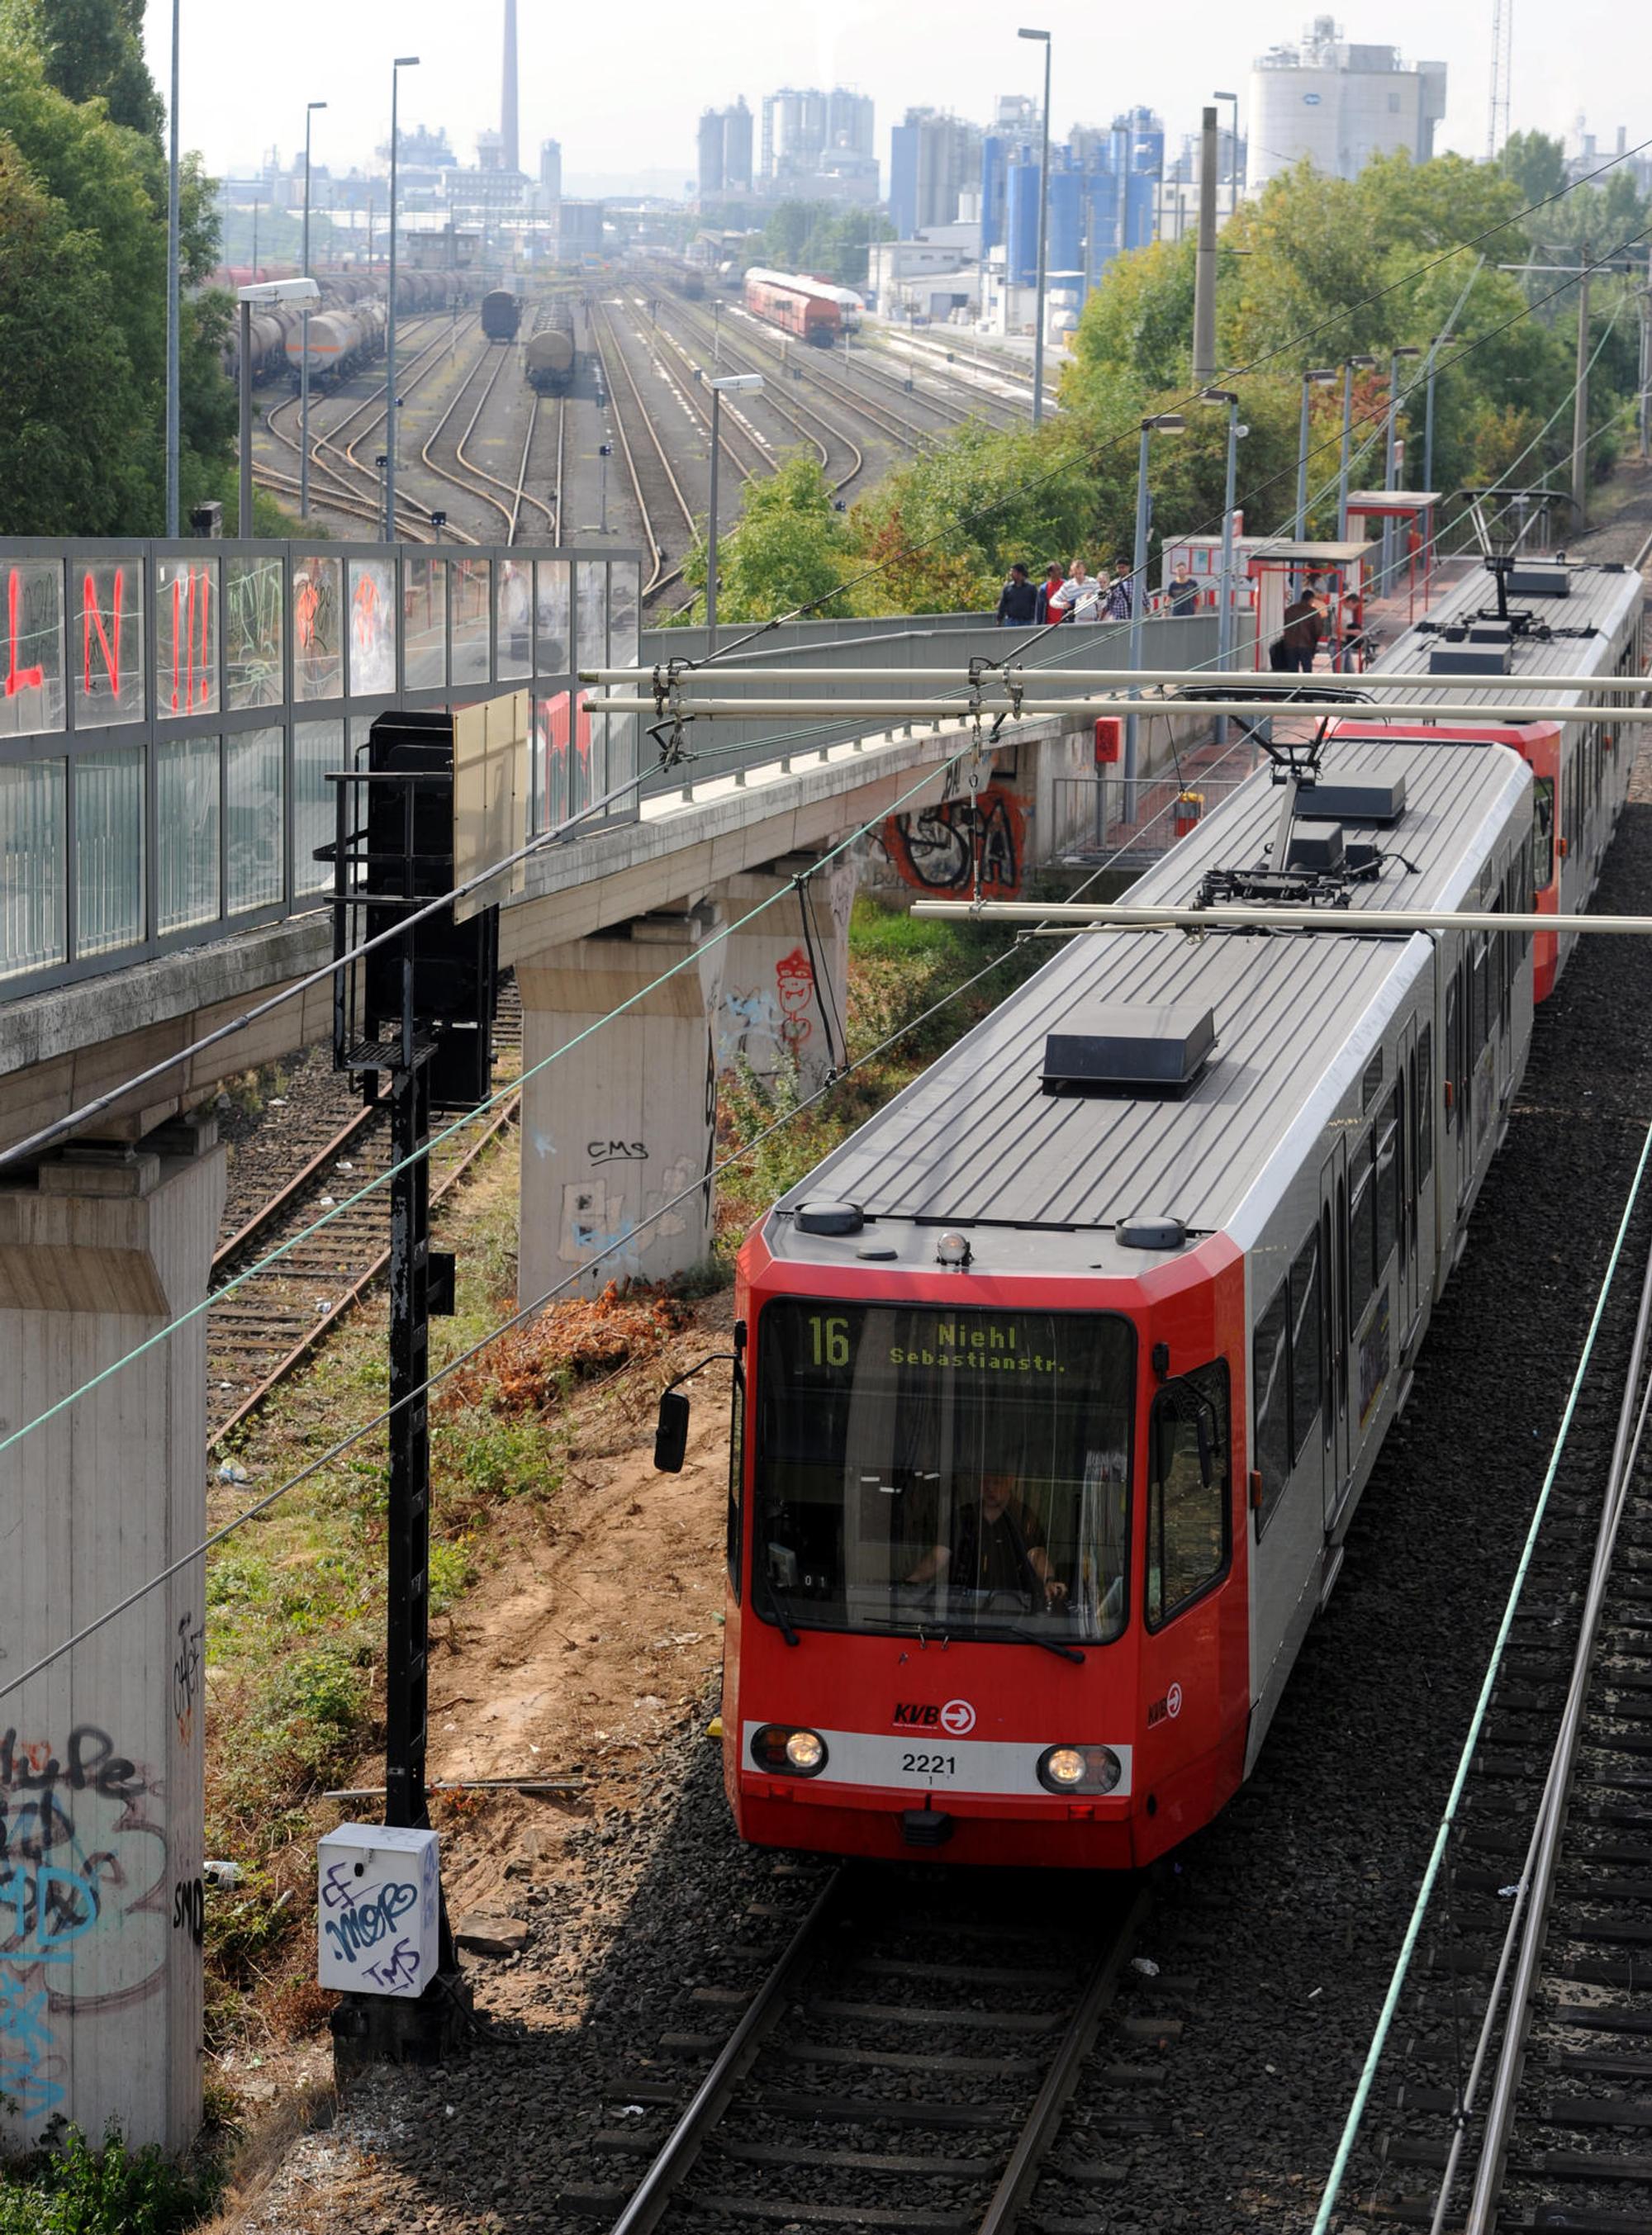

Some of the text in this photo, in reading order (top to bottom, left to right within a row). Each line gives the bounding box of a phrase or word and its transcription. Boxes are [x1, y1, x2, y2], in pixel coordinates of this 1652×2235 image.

[809, 1316, 1017, 1367] 16 Niehl
[890, 1347, 1066, 1373] Sebastianstr.
[894, 1703, 939, 1725] KVB
[902, 1753, 956, 1775] 2221
